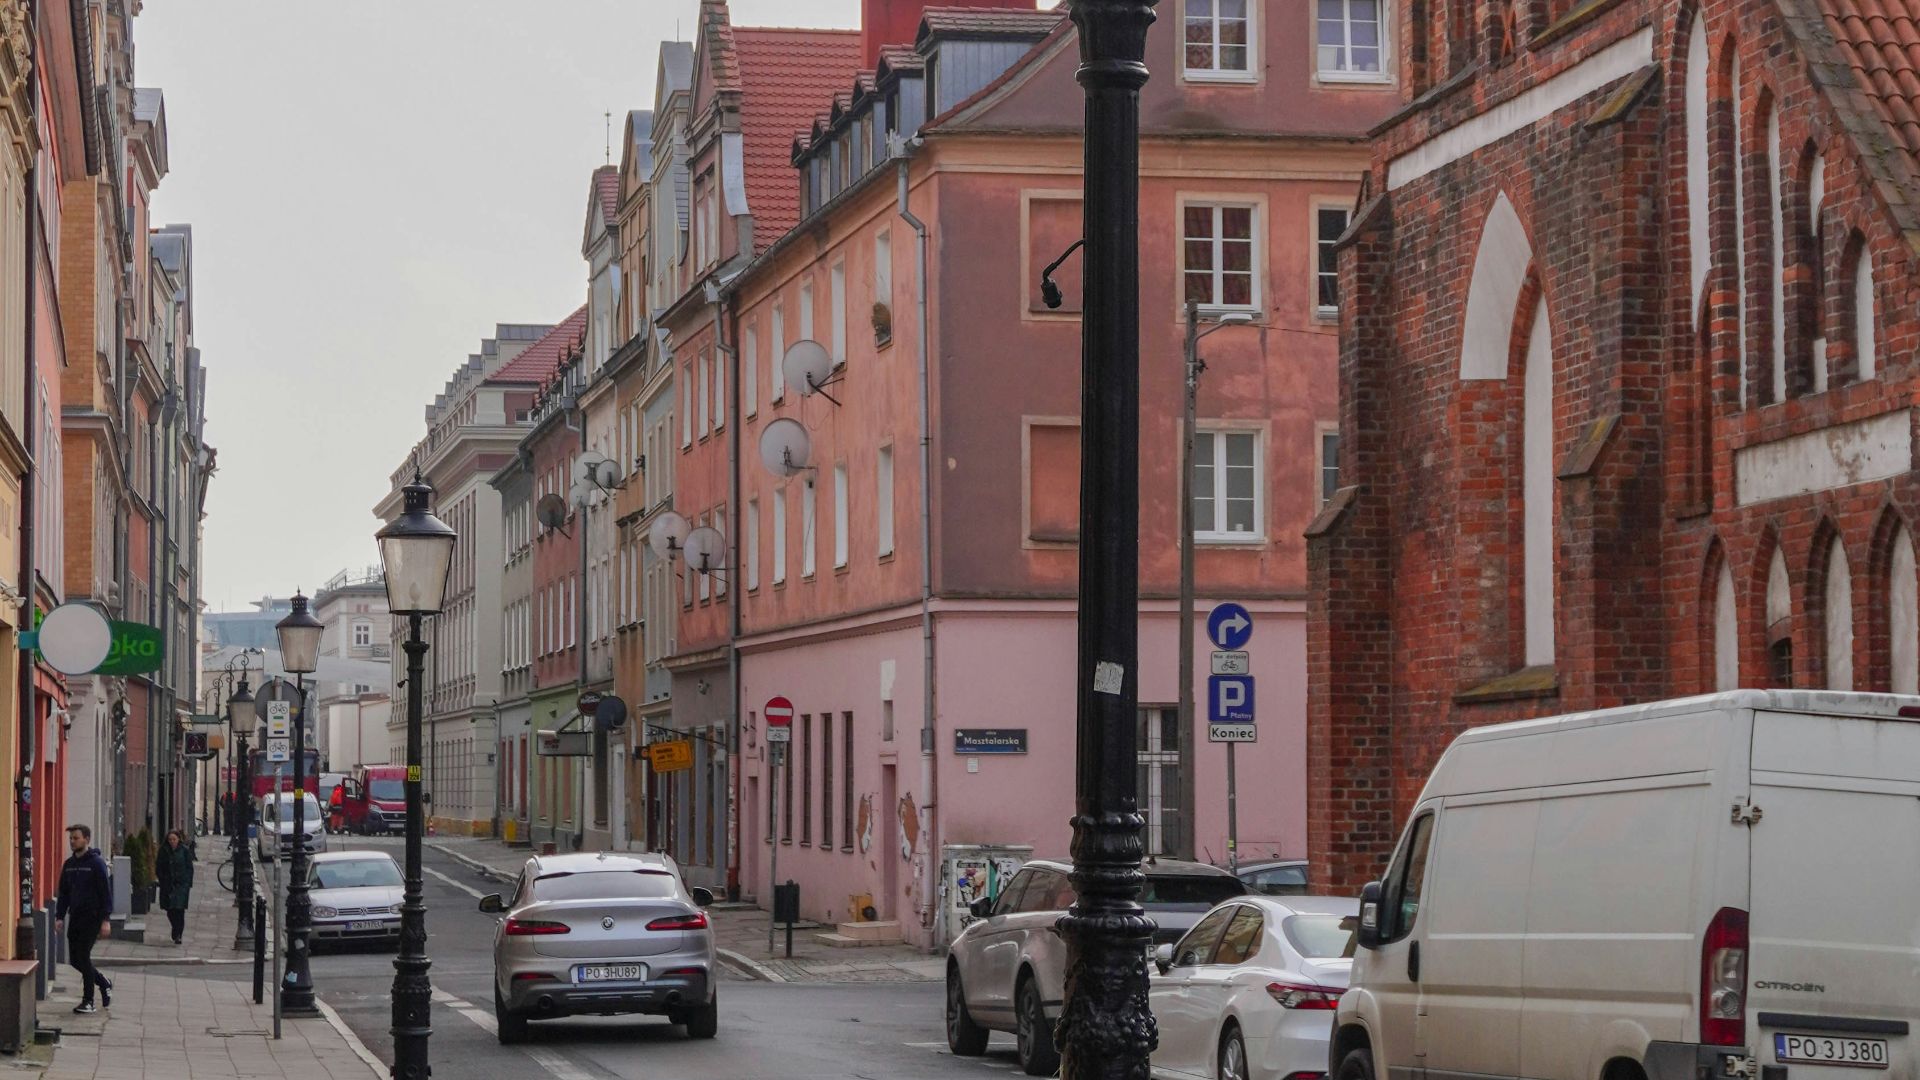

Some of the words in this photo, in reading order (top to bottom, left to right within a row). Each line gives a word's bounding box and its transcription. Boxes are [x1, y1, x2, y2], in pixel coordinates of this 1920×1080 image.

[1219, 681, 1245, 716] P
[1212, 728, 1254, 738] Koniec
[964, 737, 1019, 745] Masztalarska
[586, 968, 600, 979] PO
[604, 967, 637, 978] 3HU89
[1788, 1037, 1816, 1057] PO
[1823, 1040, 1883, 1061] 3J380
